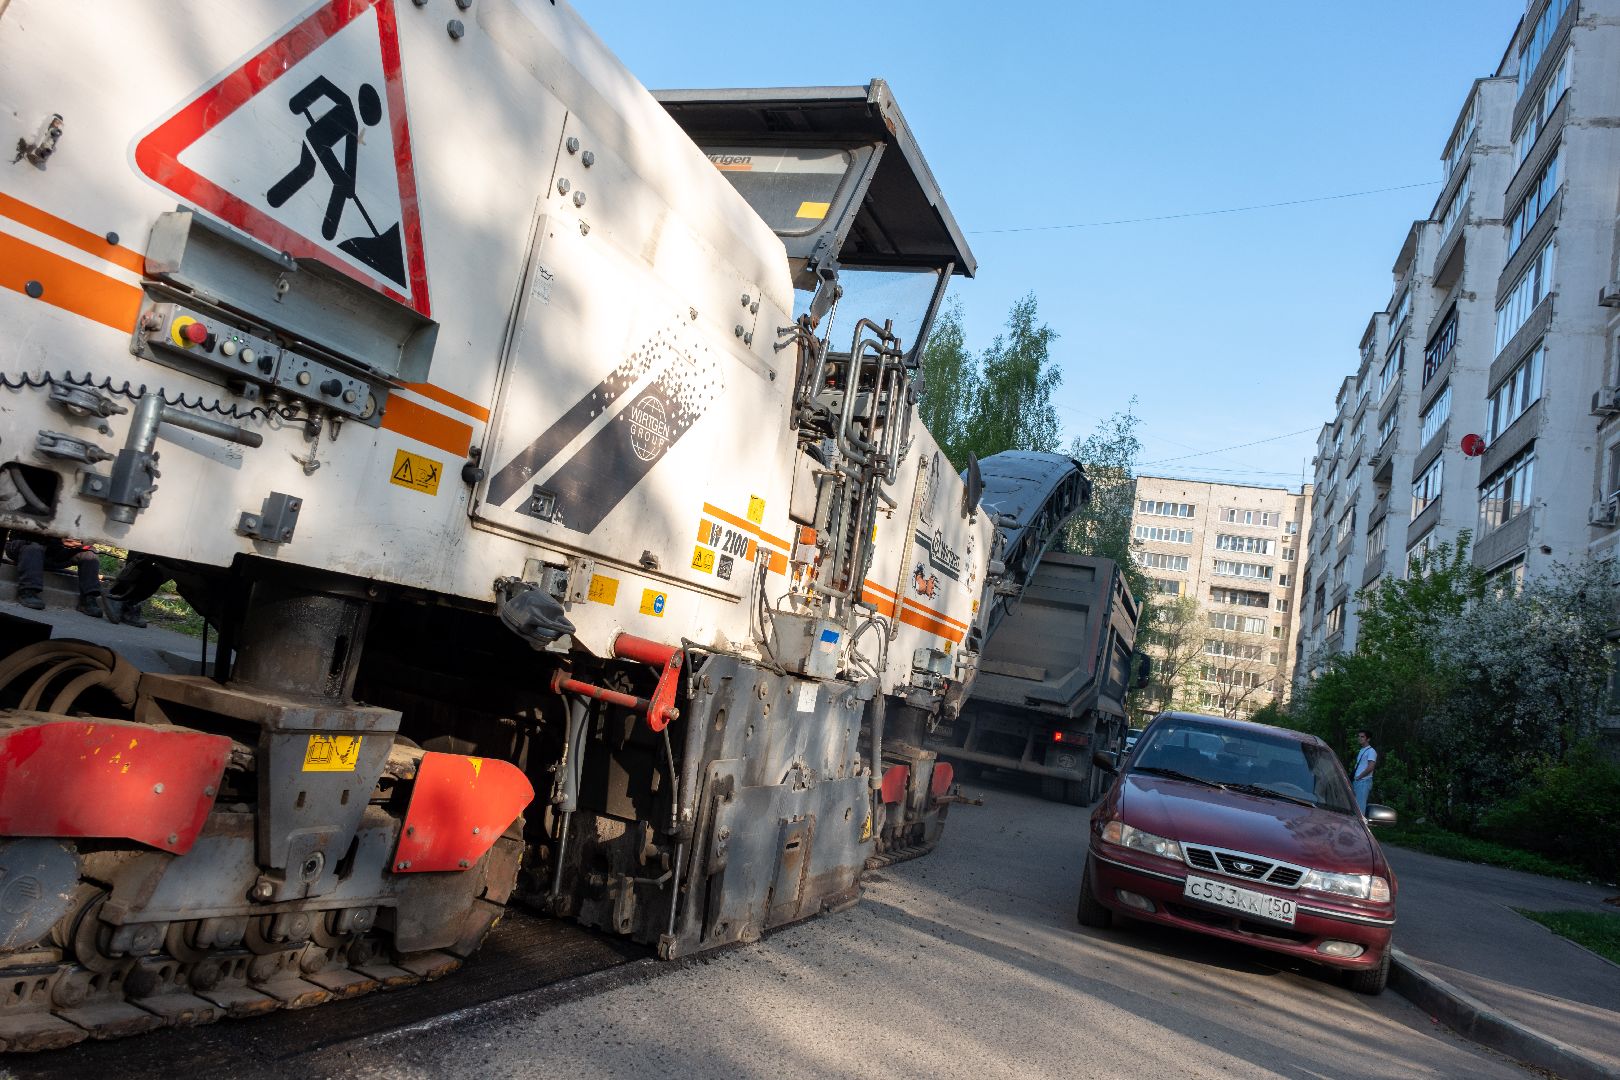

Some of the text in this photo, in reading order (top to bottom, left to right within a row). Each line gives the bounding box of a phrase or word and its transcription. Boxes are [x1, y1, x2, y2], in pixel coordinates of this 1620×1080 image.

[631, 406, 670, 437] WIRTGEN
[630, 424, 665, 448] GROUP
[722, 530, 748, 558] 2100
